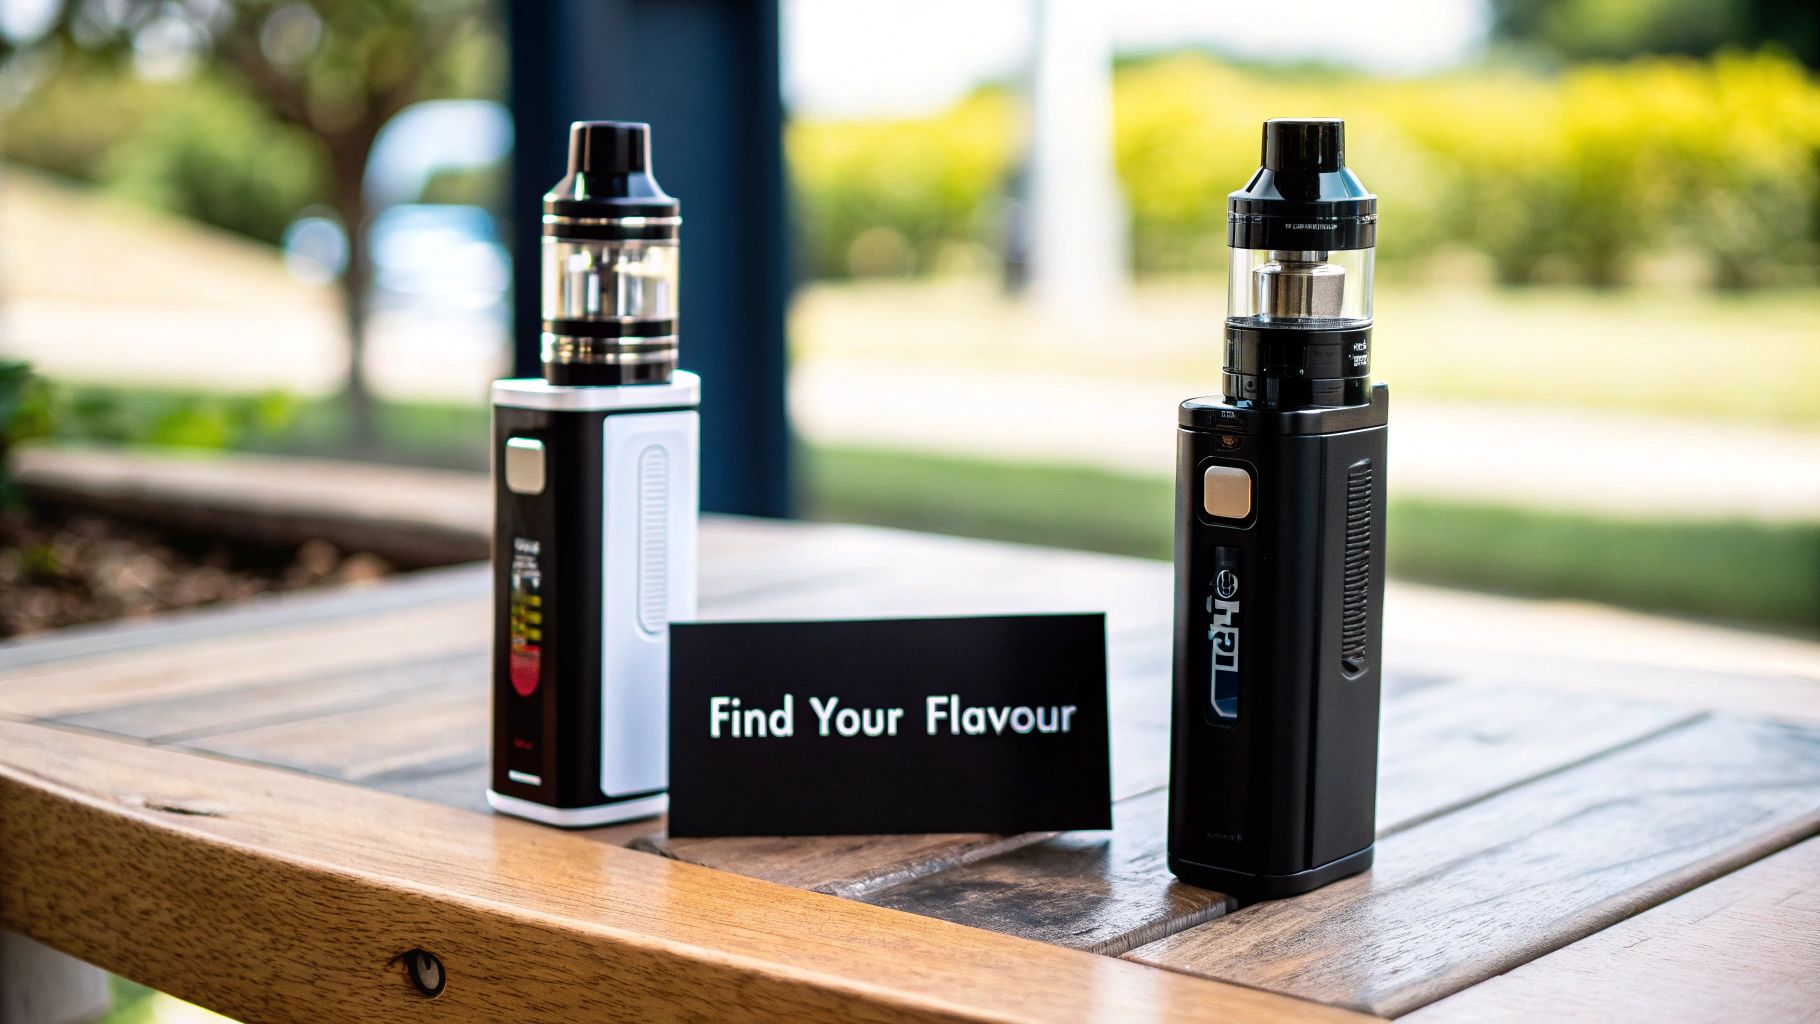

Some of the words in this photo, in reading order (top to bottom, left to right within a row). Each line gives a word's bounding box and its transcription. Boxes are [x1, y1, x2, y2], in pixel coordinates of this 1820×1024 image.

[709, 693, 794, 738] Find
[808, 696, 904, 737] Your
[925, 693, 1077, 736] Flavour
